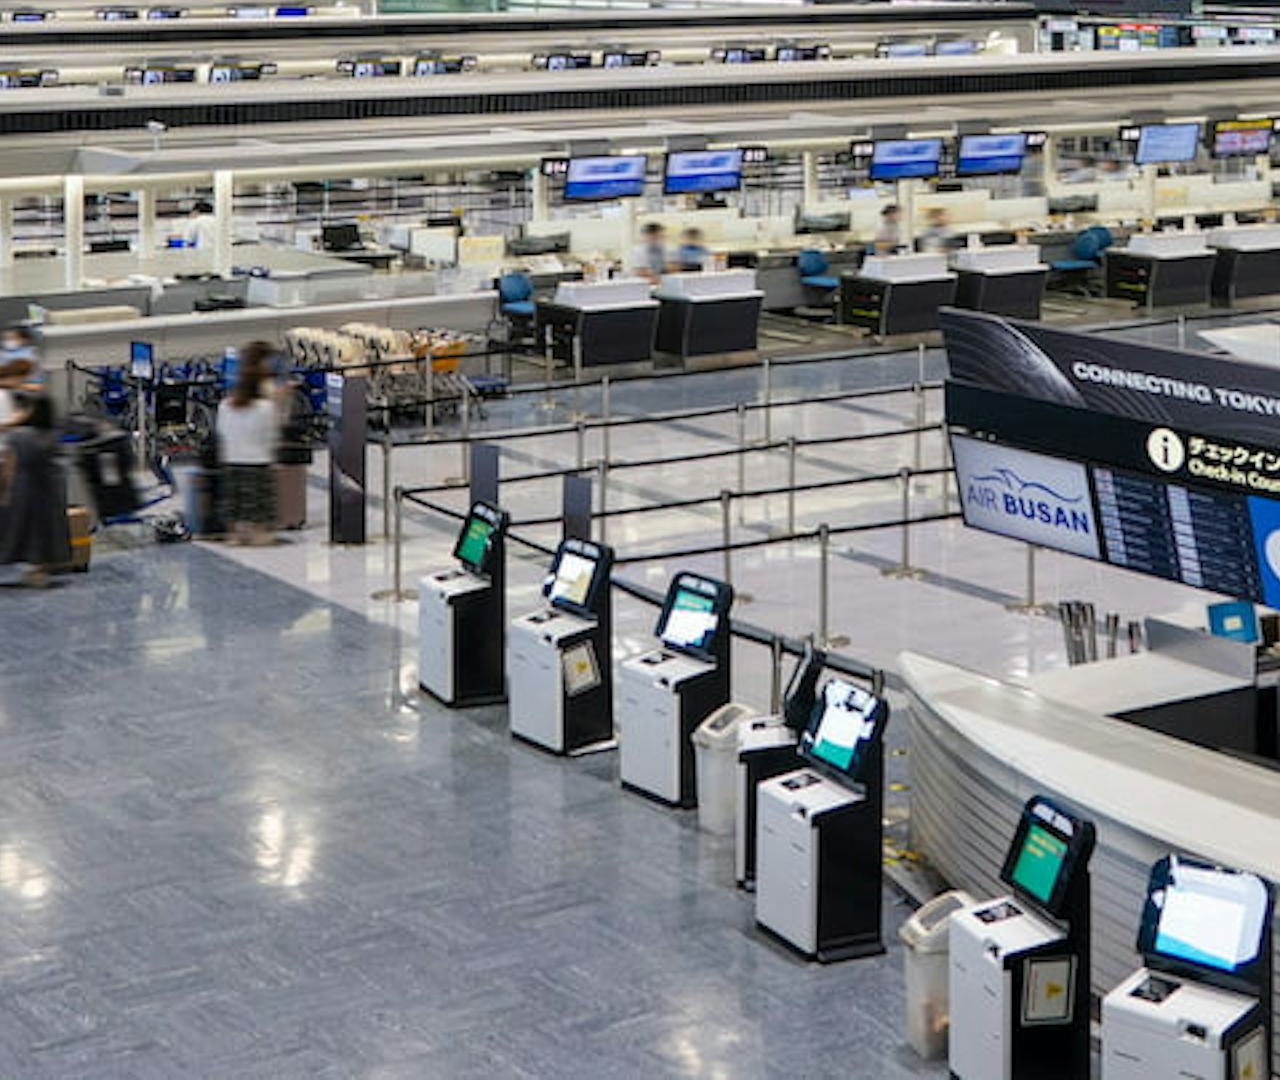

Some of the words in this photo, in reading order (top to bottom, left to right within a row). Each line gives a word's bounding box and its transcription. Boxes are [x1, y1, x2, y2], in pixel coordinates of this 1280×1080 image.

[1072, 360, 1213, 404] CONNECTING
[1188, 458, 1247, 487] Check-in
[967, 484, 999, 512] AIR
[1003, 492, 1090, 534] BUSAN
